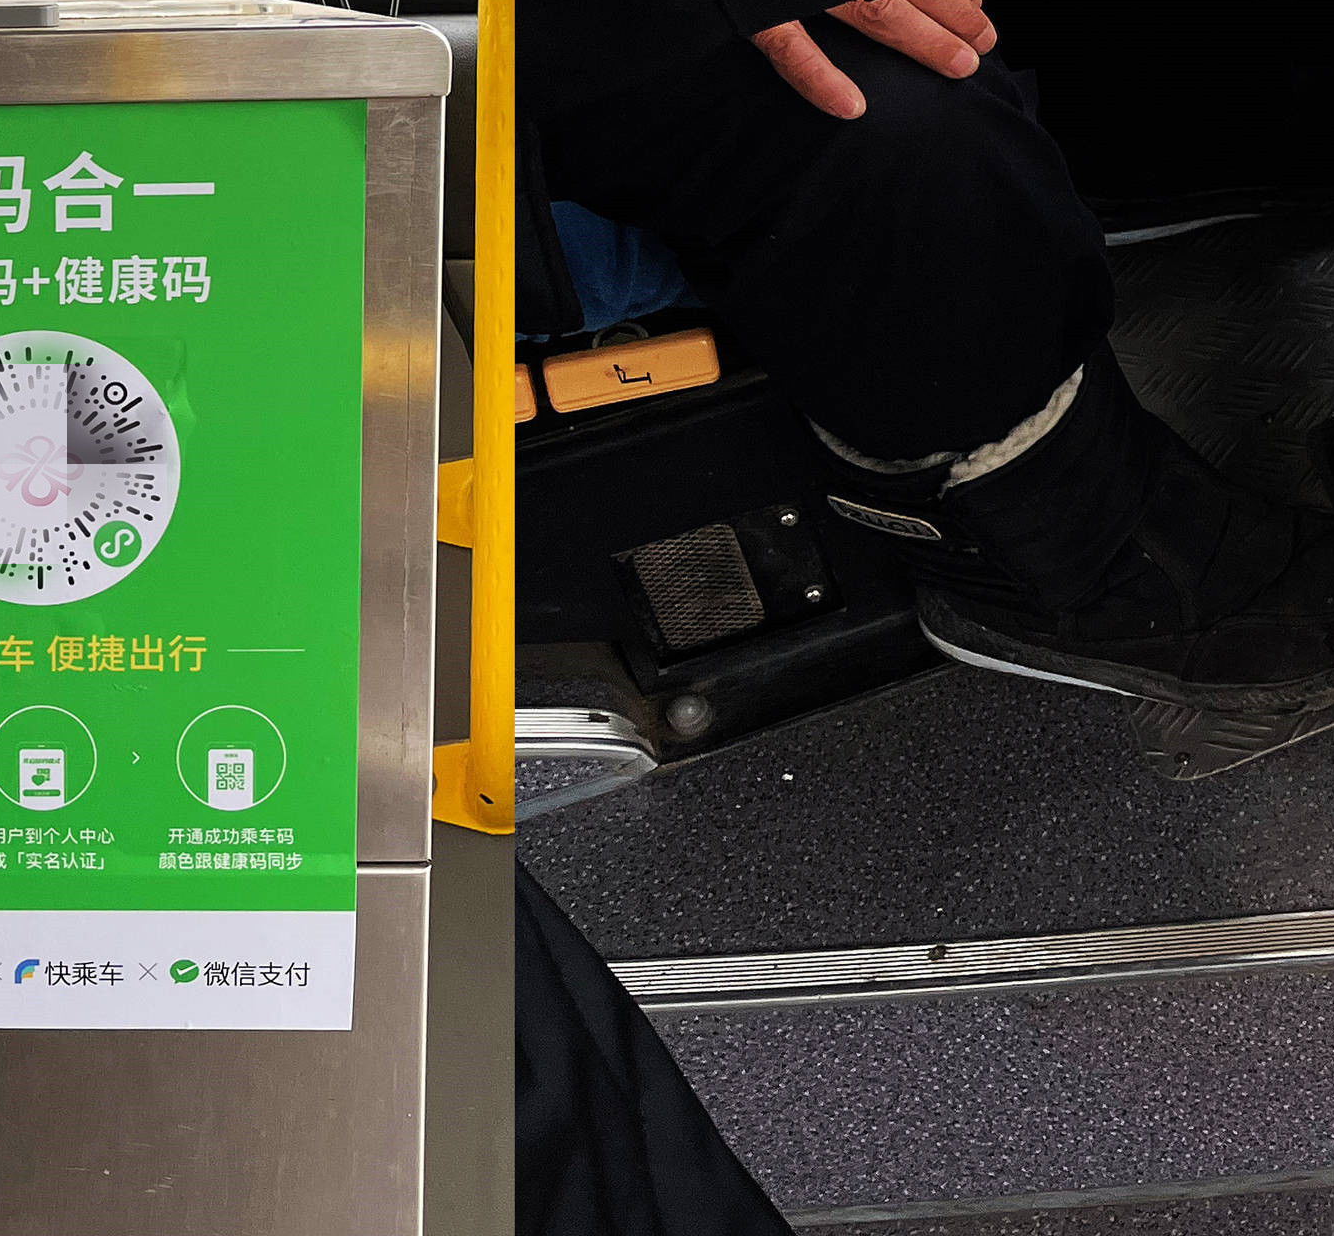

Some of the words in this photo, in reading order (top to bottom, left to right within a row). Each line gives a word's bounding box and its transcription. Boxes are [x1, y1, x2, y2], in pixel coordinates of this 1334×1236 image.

[46, 634, 209, 674] 便捷出行
[168, 827, 295, 846] 开通成功乘车码
[158, 851, 303, 872] 颜色跟健康码同步
[45, 960, 125, 988] 快乘车
[203, 960, 312, 989] 微信支付
